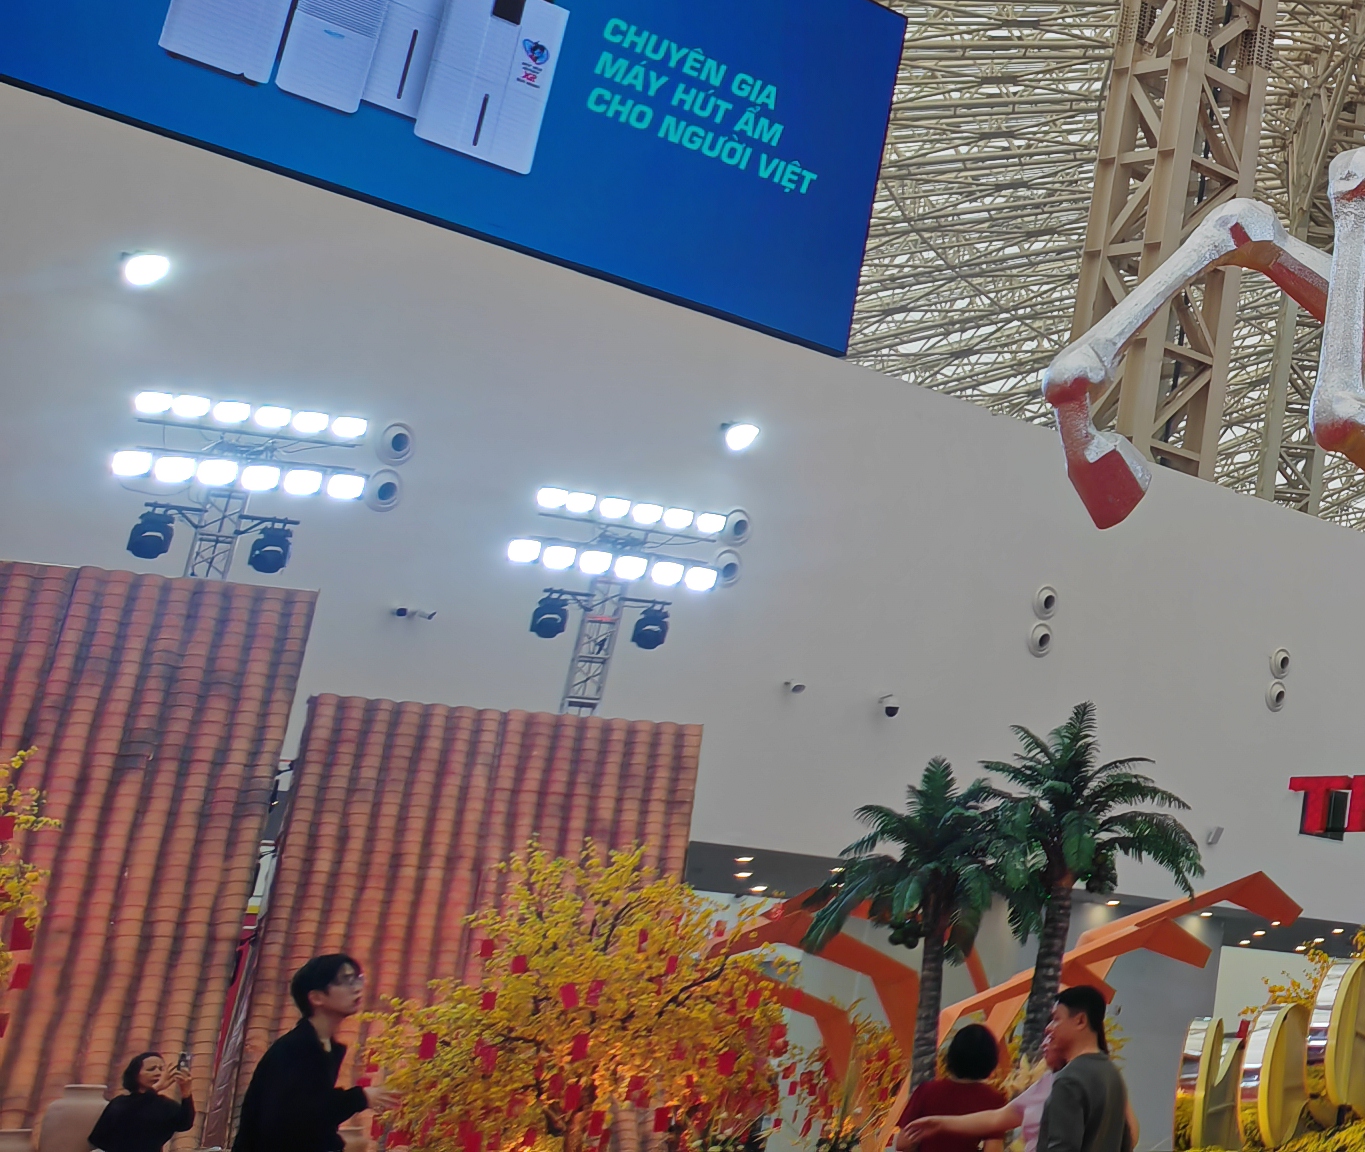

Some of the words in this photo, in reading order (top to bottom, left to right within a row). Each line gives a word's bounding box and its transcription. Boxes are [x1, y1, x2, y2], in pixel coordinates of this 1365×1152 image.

[594, 51, 669, 97] MÁY
[671, 83, 734, 124] HÚT
[603, 18, 728, 87] CHUYÊN
[731, 73, 777, 110] GIA
[586, 87, 655, 130] CHO
[658, 114, 753, 170] NGƯỜI
[758, 153, 818, 194] VIỆT
